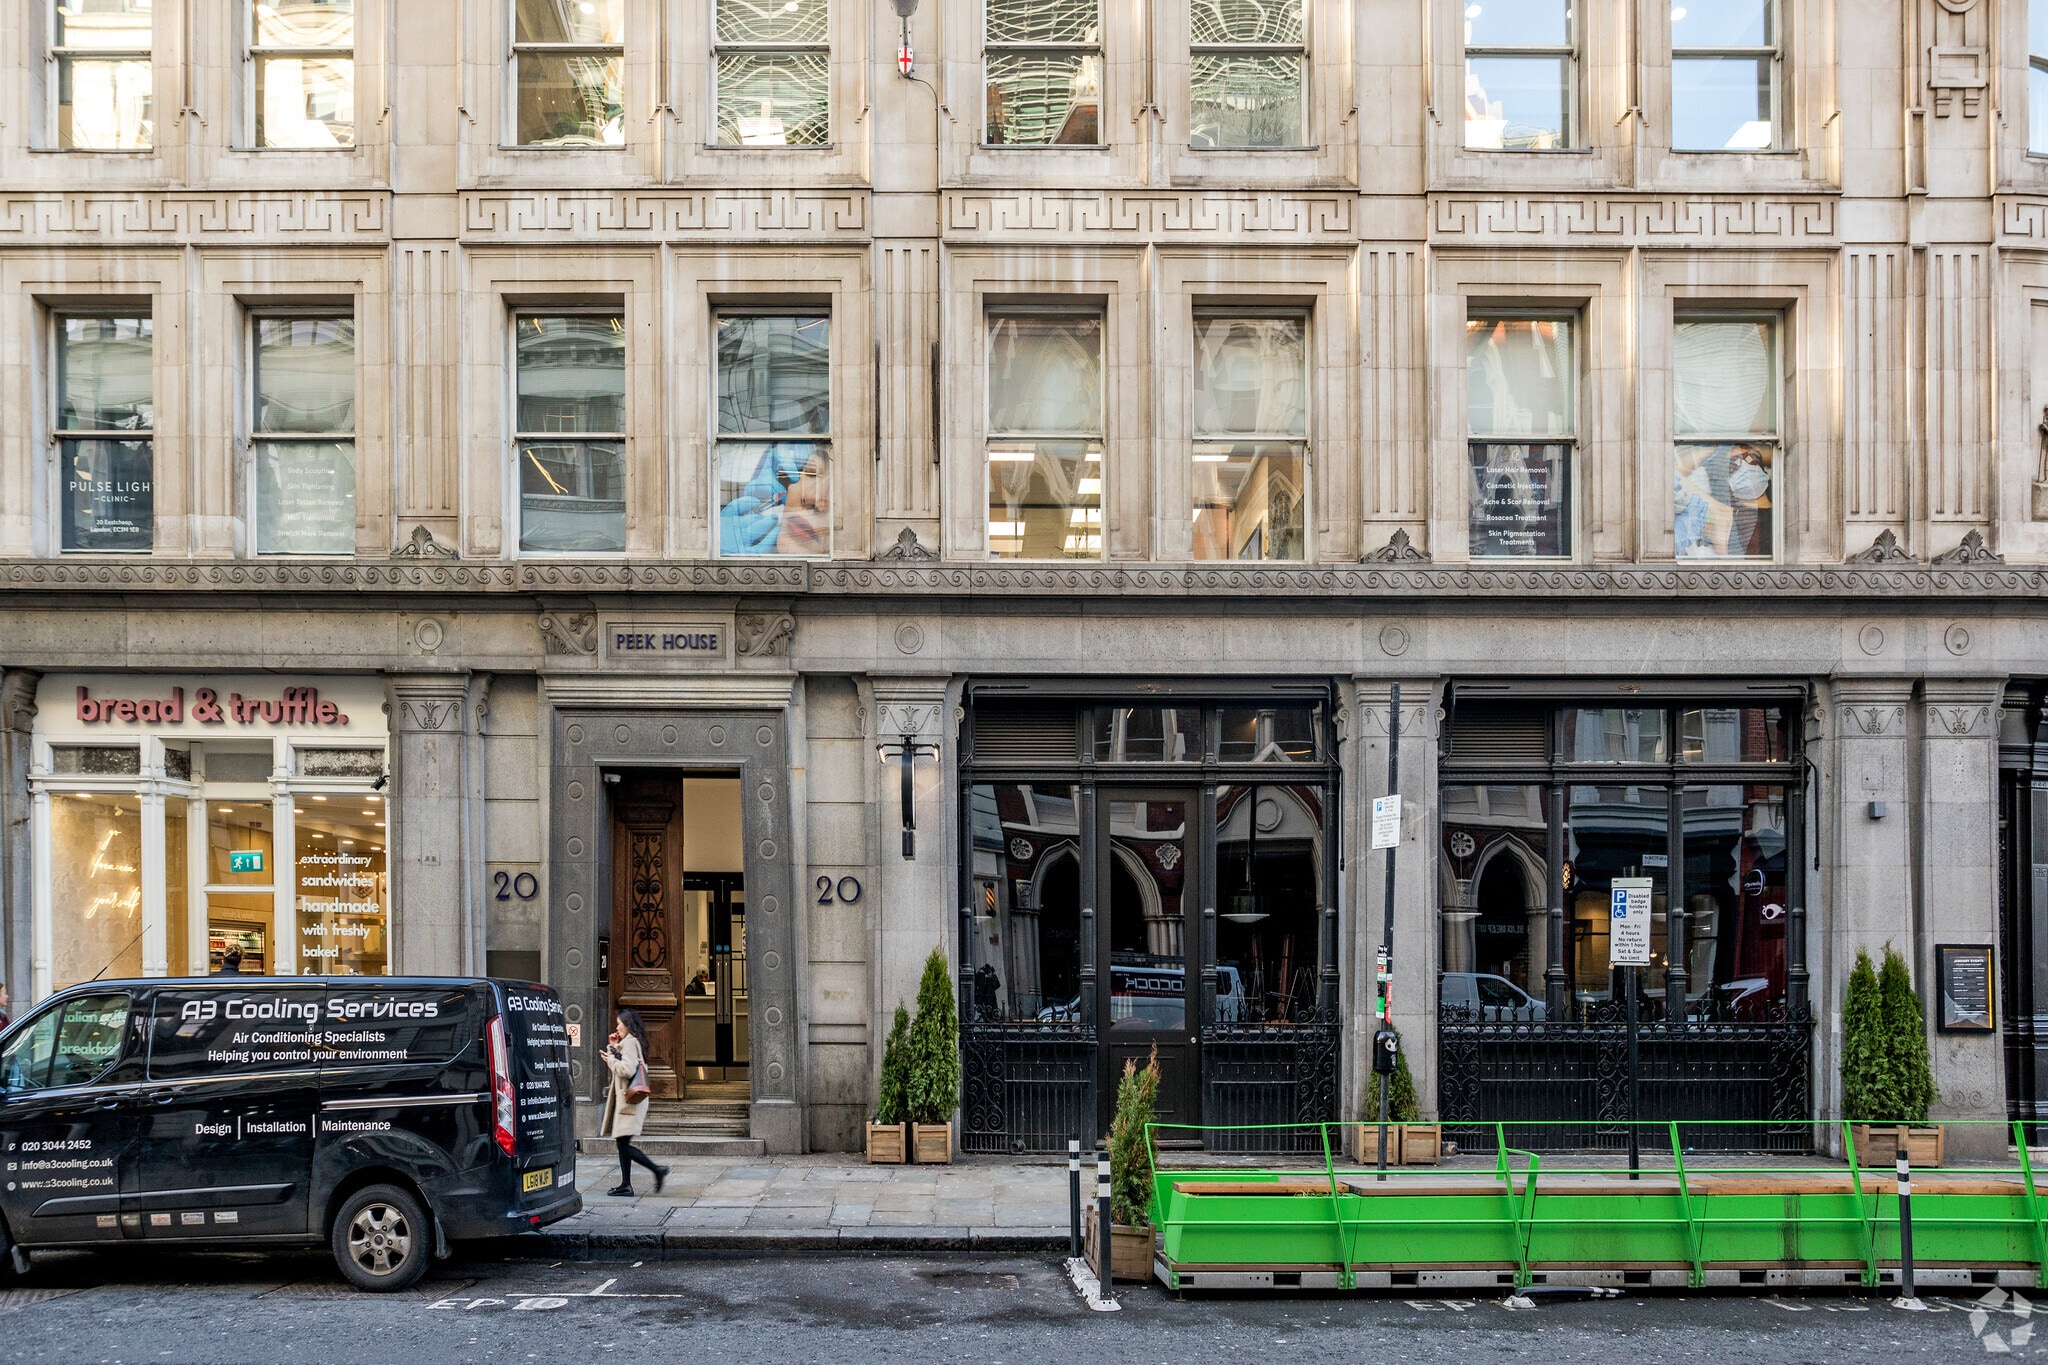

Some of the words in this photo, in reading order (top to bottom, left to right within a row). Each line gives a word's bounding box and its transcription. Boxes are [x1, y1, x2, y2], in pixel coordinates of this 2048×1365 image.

[70, 482, 112, 491] PULSE
[118, 482, 153, 491] LIGH
[1503, 530, 1545, 538] Pigmentation
[616, 634, 656, 650] PEEK
[662, 634, 717, 650] HOUSE
[76, 685, 183, 723] bread
[192, 687, 224, 722] &
[228, 686, 349, 725] truffle.
[300, 853, 372, 867] extraordinary
[301, 872, 374, 887] sandwiches
[494, 871, 538, 901] 20
[816, 875, 862, 906] 20
[302, 897, 380, 913] handmade
[301, 923, 328, 935] with
[332, 923, 371, 940] freshly
[302, 944, 338, 957] baked
[181, 1000, 217, 1020] A3
[225, 1000, 318, 1024] Cooling
[326, 998, 439, 1019] Services
[508, 996, 523, 1011] A3
[523, 997, 550, 1016] Cooling
[232, 1032, 250, 1044] Air
[251, 1031, 322, 1045] Conditioning
[324, 1031, 385, 1044] Specialists
[208, 1050, 249, 1063] Helping
[250, 1052, 271, 1062] you
[272, 1049, 311, 1060] control
[312, 1051, 337, 1061] your
[339, 1048, 408, 1060] environment
[195, 1123, 232, 1136] Design
[247, 1121, 306, 1133] Installation
[321, 1120, 391, 1131] Maintenance
[22, 1142, 40, 1151] 020
[42, 1141, 66, 1151] 3044
[67, 1140, 91, 1150] 2452
[22, 1158, 113, 1170] info@a3cooling.co.uk
